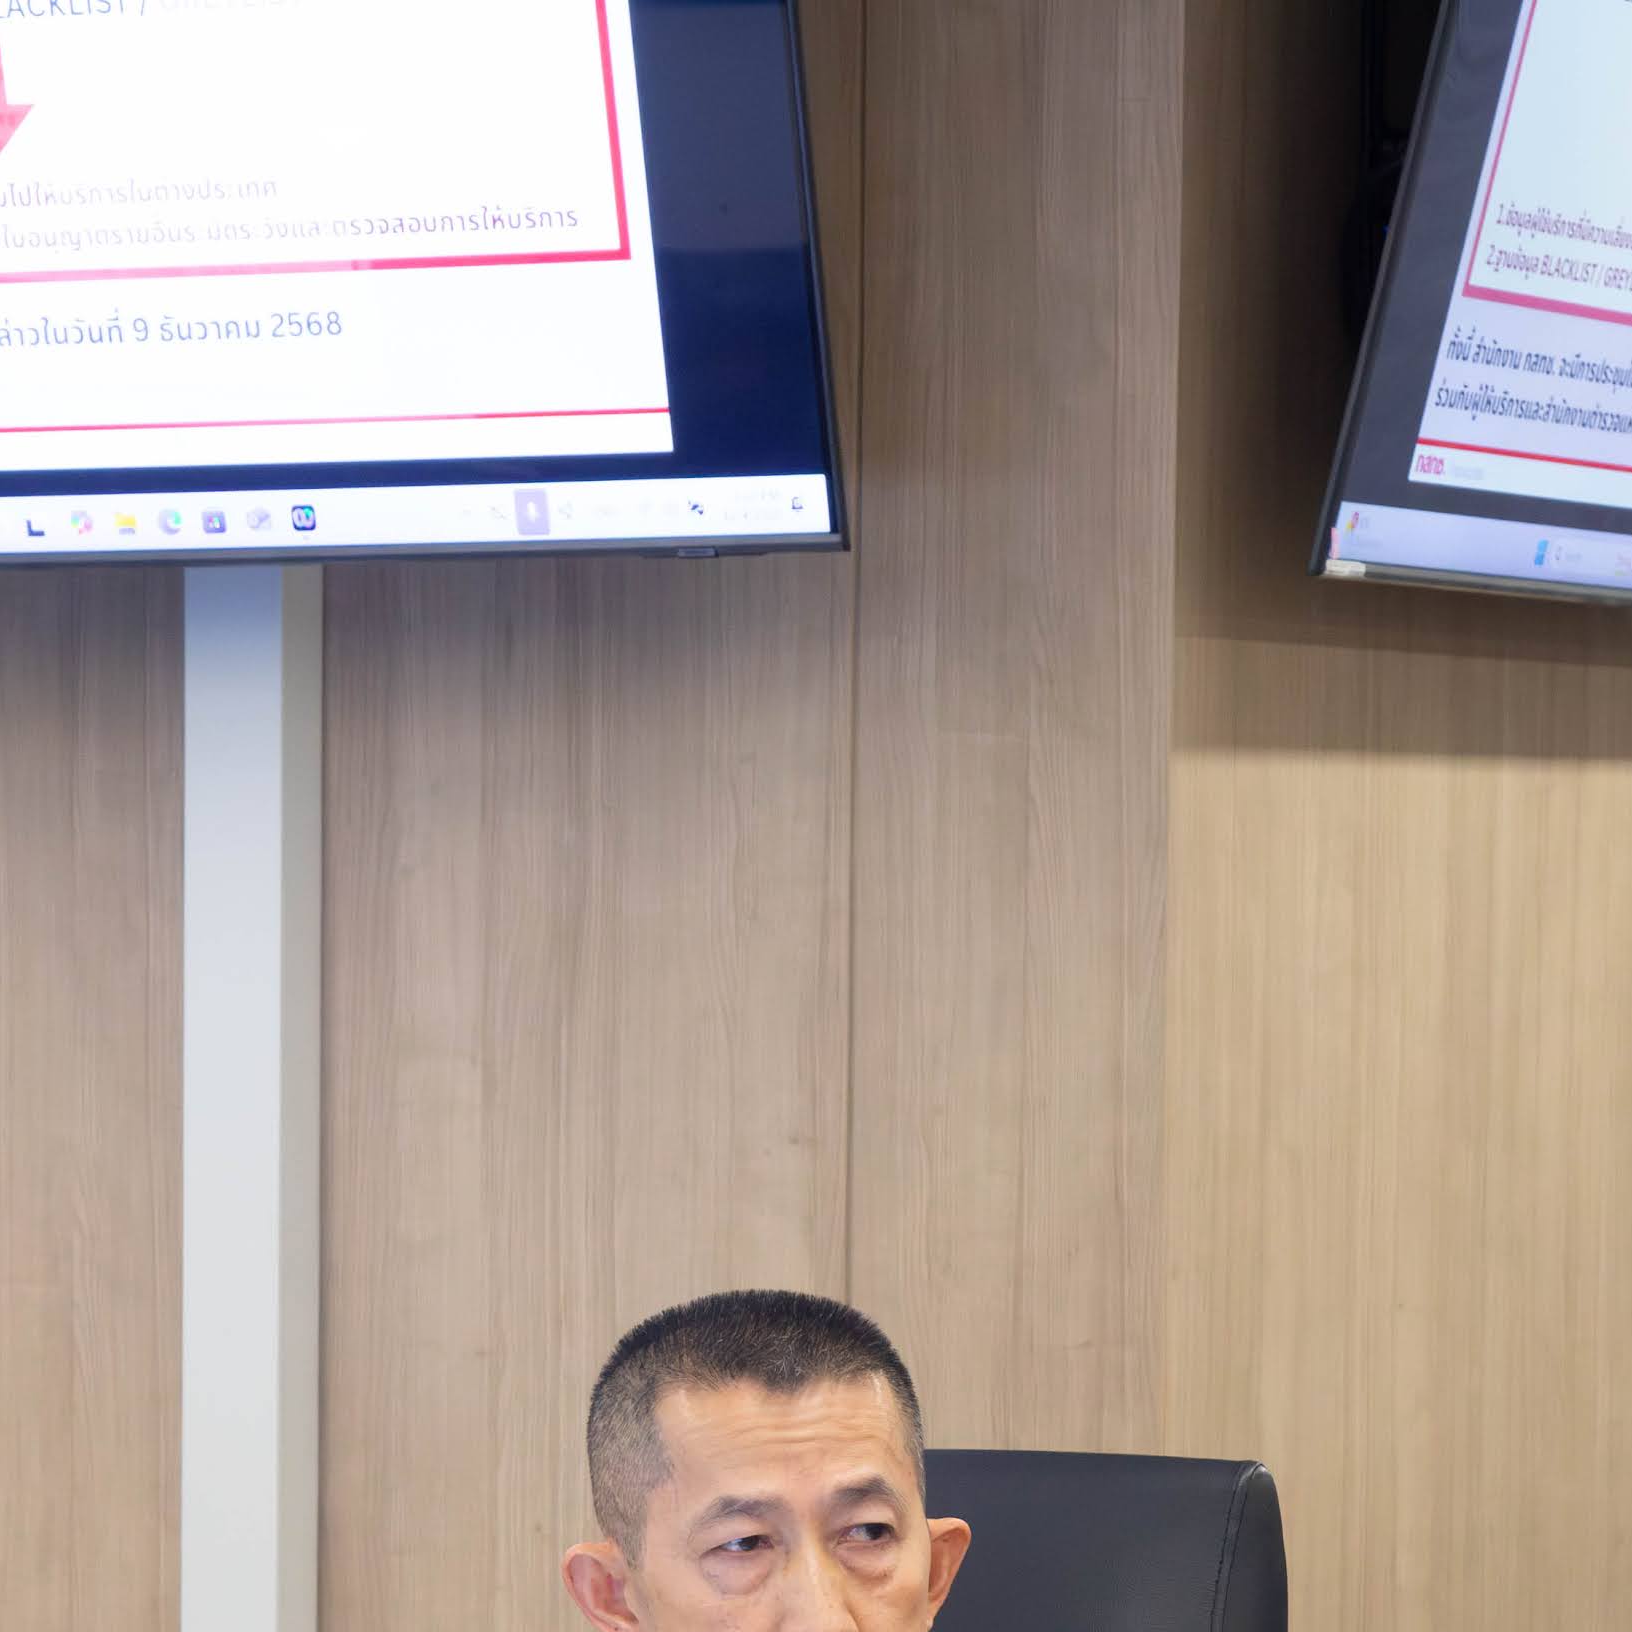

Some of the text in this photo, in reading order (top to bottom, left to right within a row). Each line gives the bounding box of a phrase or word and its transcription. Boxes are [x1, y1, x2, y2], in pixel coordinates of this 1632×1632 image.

[1540, 254, 1598, 284] BLACKLIST
[133, 318, 150, 343] 9
[160, 314, 261, 343] ธันวาคม
[271, 311, 343, 338] 2568
